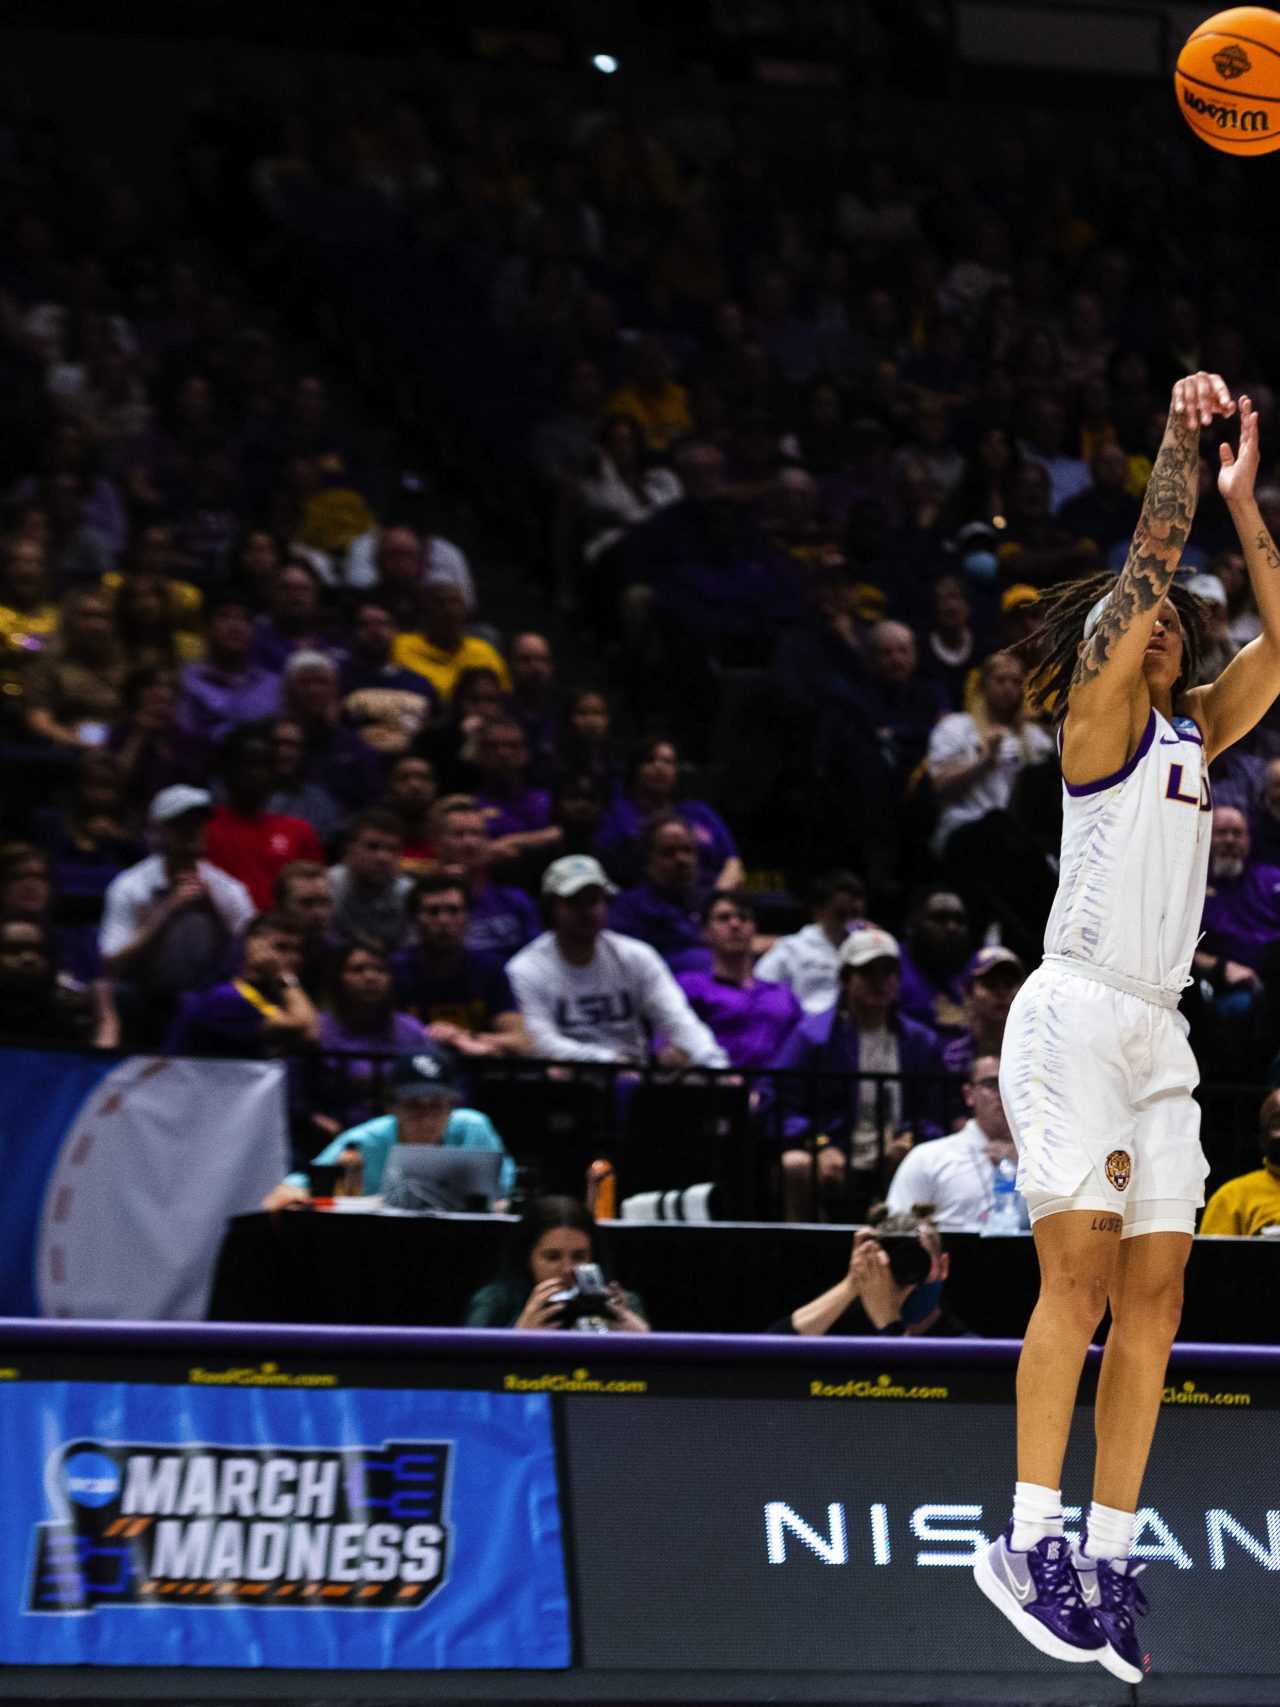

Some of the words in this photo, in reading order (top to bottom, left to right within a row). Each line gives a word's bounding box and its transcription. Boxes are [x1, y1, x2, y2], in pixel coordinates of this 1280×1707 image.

[1184, 86, 1269, 131] Wilson
[120, 1455, 340, 1518] MARCH
[150, 1519, 443, 1582] MADNESS
